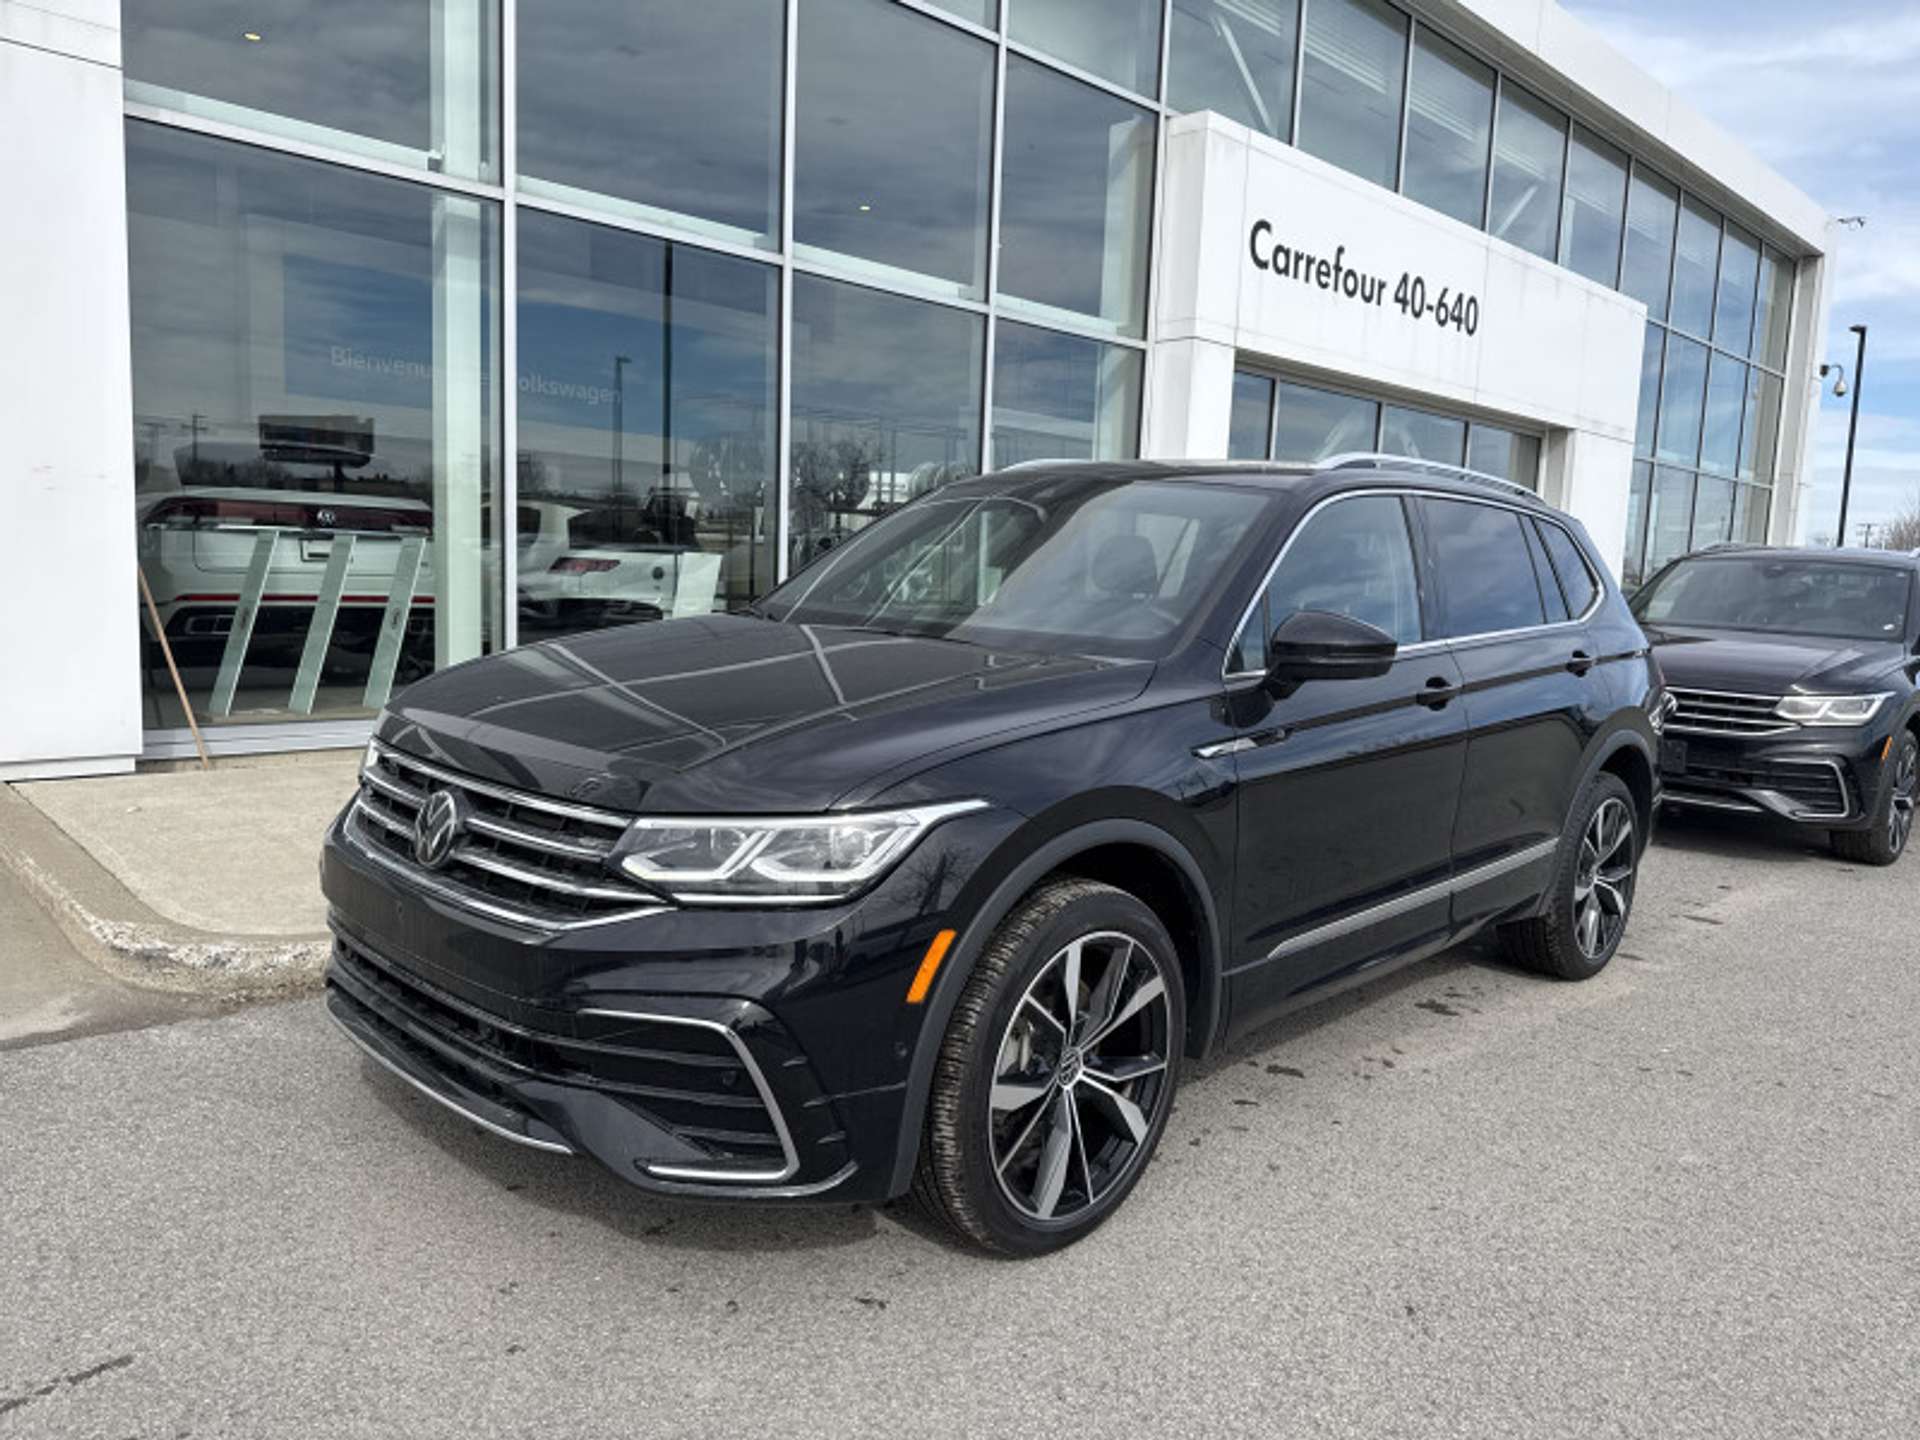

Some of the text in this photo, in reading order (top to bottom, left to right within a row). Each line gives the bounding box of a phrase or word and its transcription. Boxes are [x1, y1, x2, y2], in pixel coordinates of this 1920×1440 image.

[1249, 219, 1479, 336] Carrefour 40-640
[330, 345, 435, 378] Bienvenu
[519, 375, 621, 405] olkswagen
